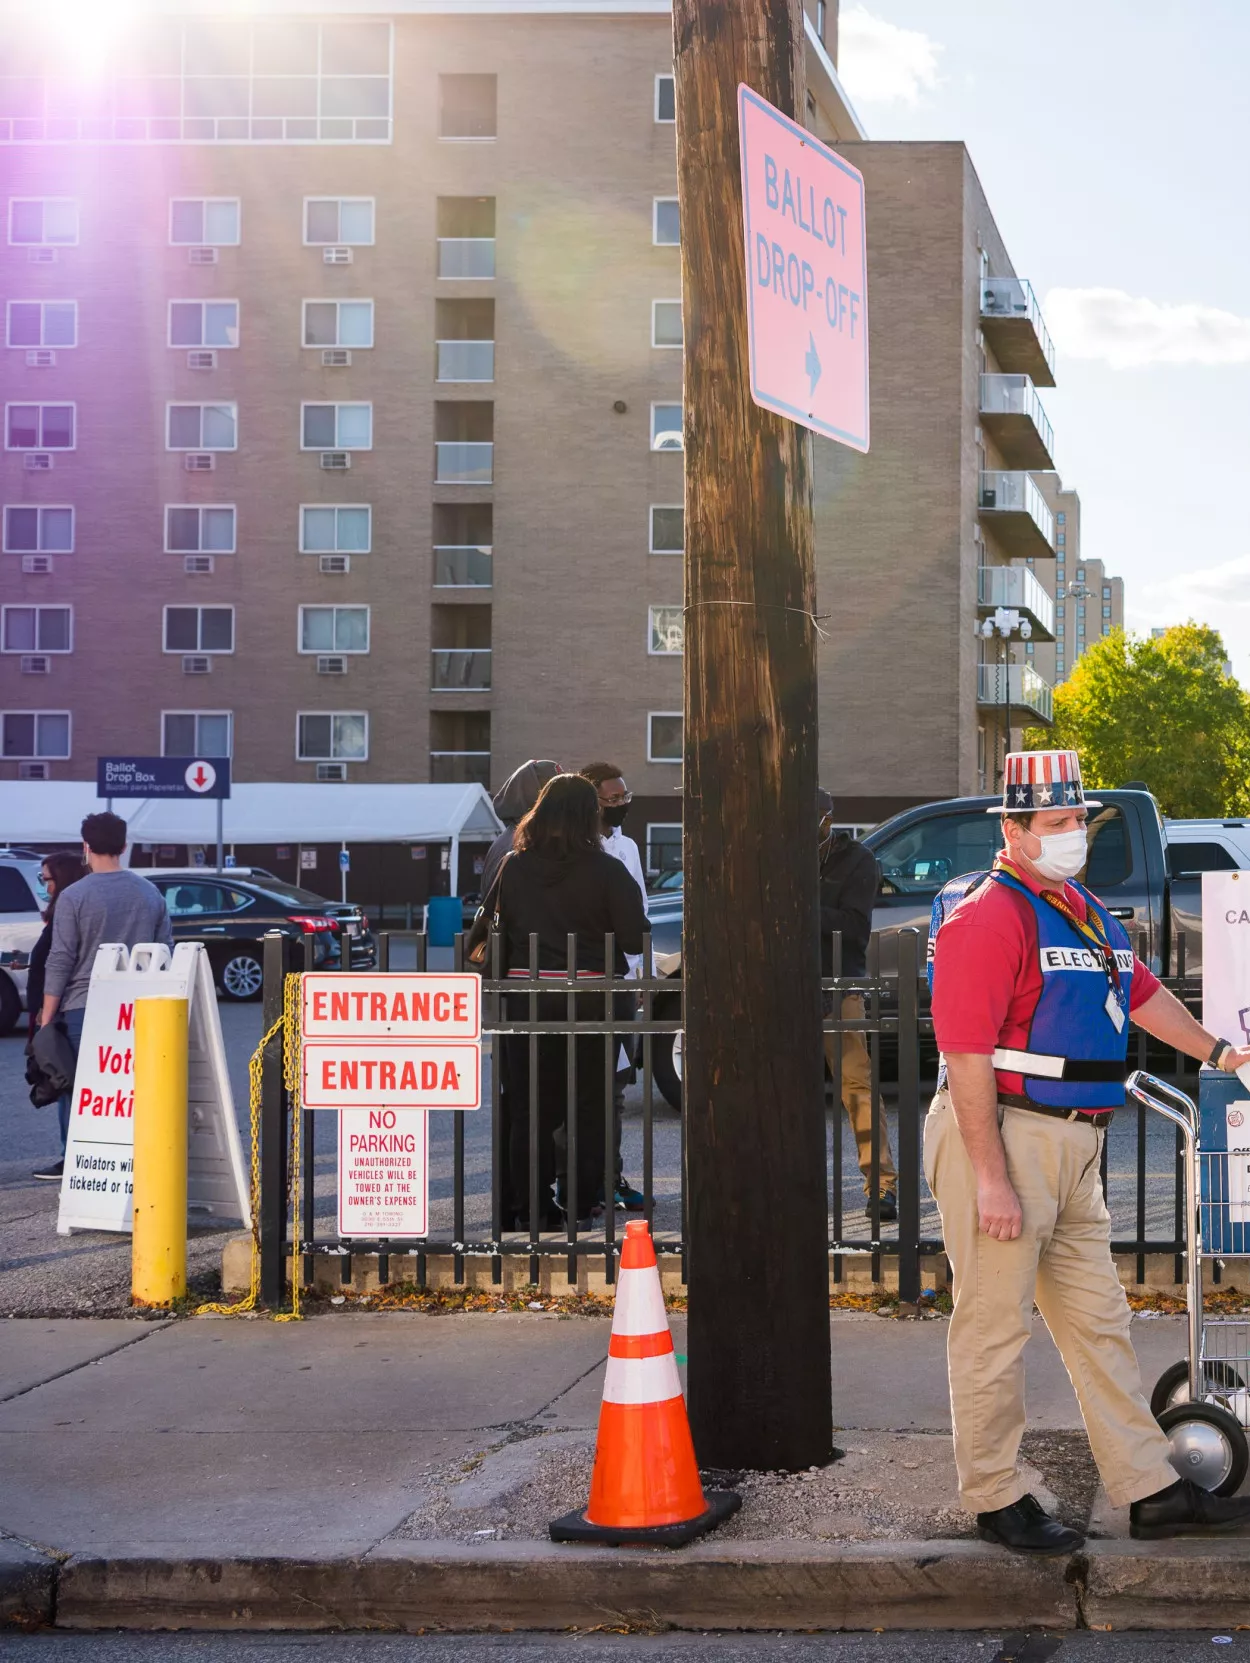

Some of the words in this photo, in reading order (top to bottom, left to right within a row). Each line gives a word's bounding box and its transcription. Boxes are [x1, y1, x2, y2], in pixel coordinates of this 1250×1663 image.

[764, 153, 847, 256] BALLOT
[756, 232, 860, 339] DROP-OFF
[105, 762, 136, 772] Ballot
[105, 772, 132, 783] Drop
[135, 772, 155, 782] Box
[313, 991, 468, 1022] ENTRANCE
[117, 1003, 135, 1031] N
[98, 1045, 135, 1075] Vot
[322, 1061, 460, 1090] ENTRADA
[78, 1087, 134, 1118] Parki
[369, 1110, 396, 1129] NO
[350, 1134, 415, 1153] PARKING
[76, 1154, 116, 1171] Violators
[354, 1157, 411, 1167] UNAUTHORIZED
[70, 1176, 108, 1192] ticketed
[111, 1181, 121, 1193] or
[348, 1170, 384, 1180] VEHICLES
[387, 1170, 405, 1180] WILL
[407, 1170, 417, 1180] BE
[355, 1183, 381, 1193] TOWED
[384, 1183, 394, 1193] AT
[397, 1183, 411, 1193] THE
[348, 1196, 382, 1206] OWNER'S
[384, 1196, 417, 1206] EXPENSE
